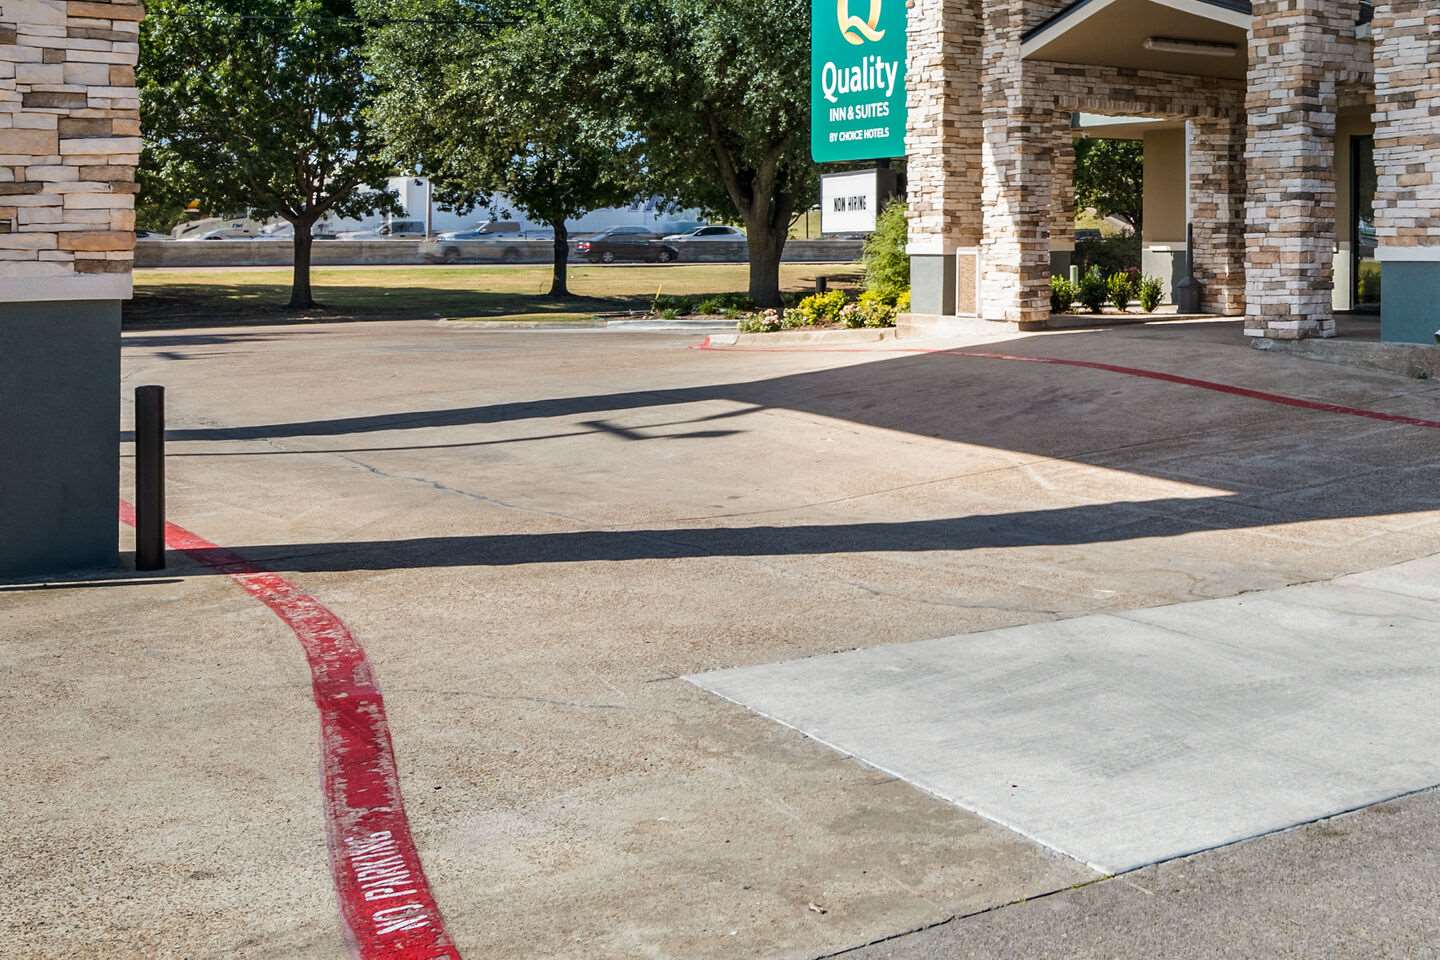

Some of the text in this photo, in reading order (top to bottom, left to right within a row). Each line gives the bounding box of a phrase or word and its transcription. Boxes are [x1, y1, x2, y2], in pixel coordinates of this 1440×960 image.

[822, 55, 898, 103] Quality
[829, 101, 889, 122] INN & SUITES
[829, 127, 890, 143] BY CHOICE HOTELS
[833, 195, 866, 212] NOW HIRING
[343, 830, 430, 935] NO PARKING
